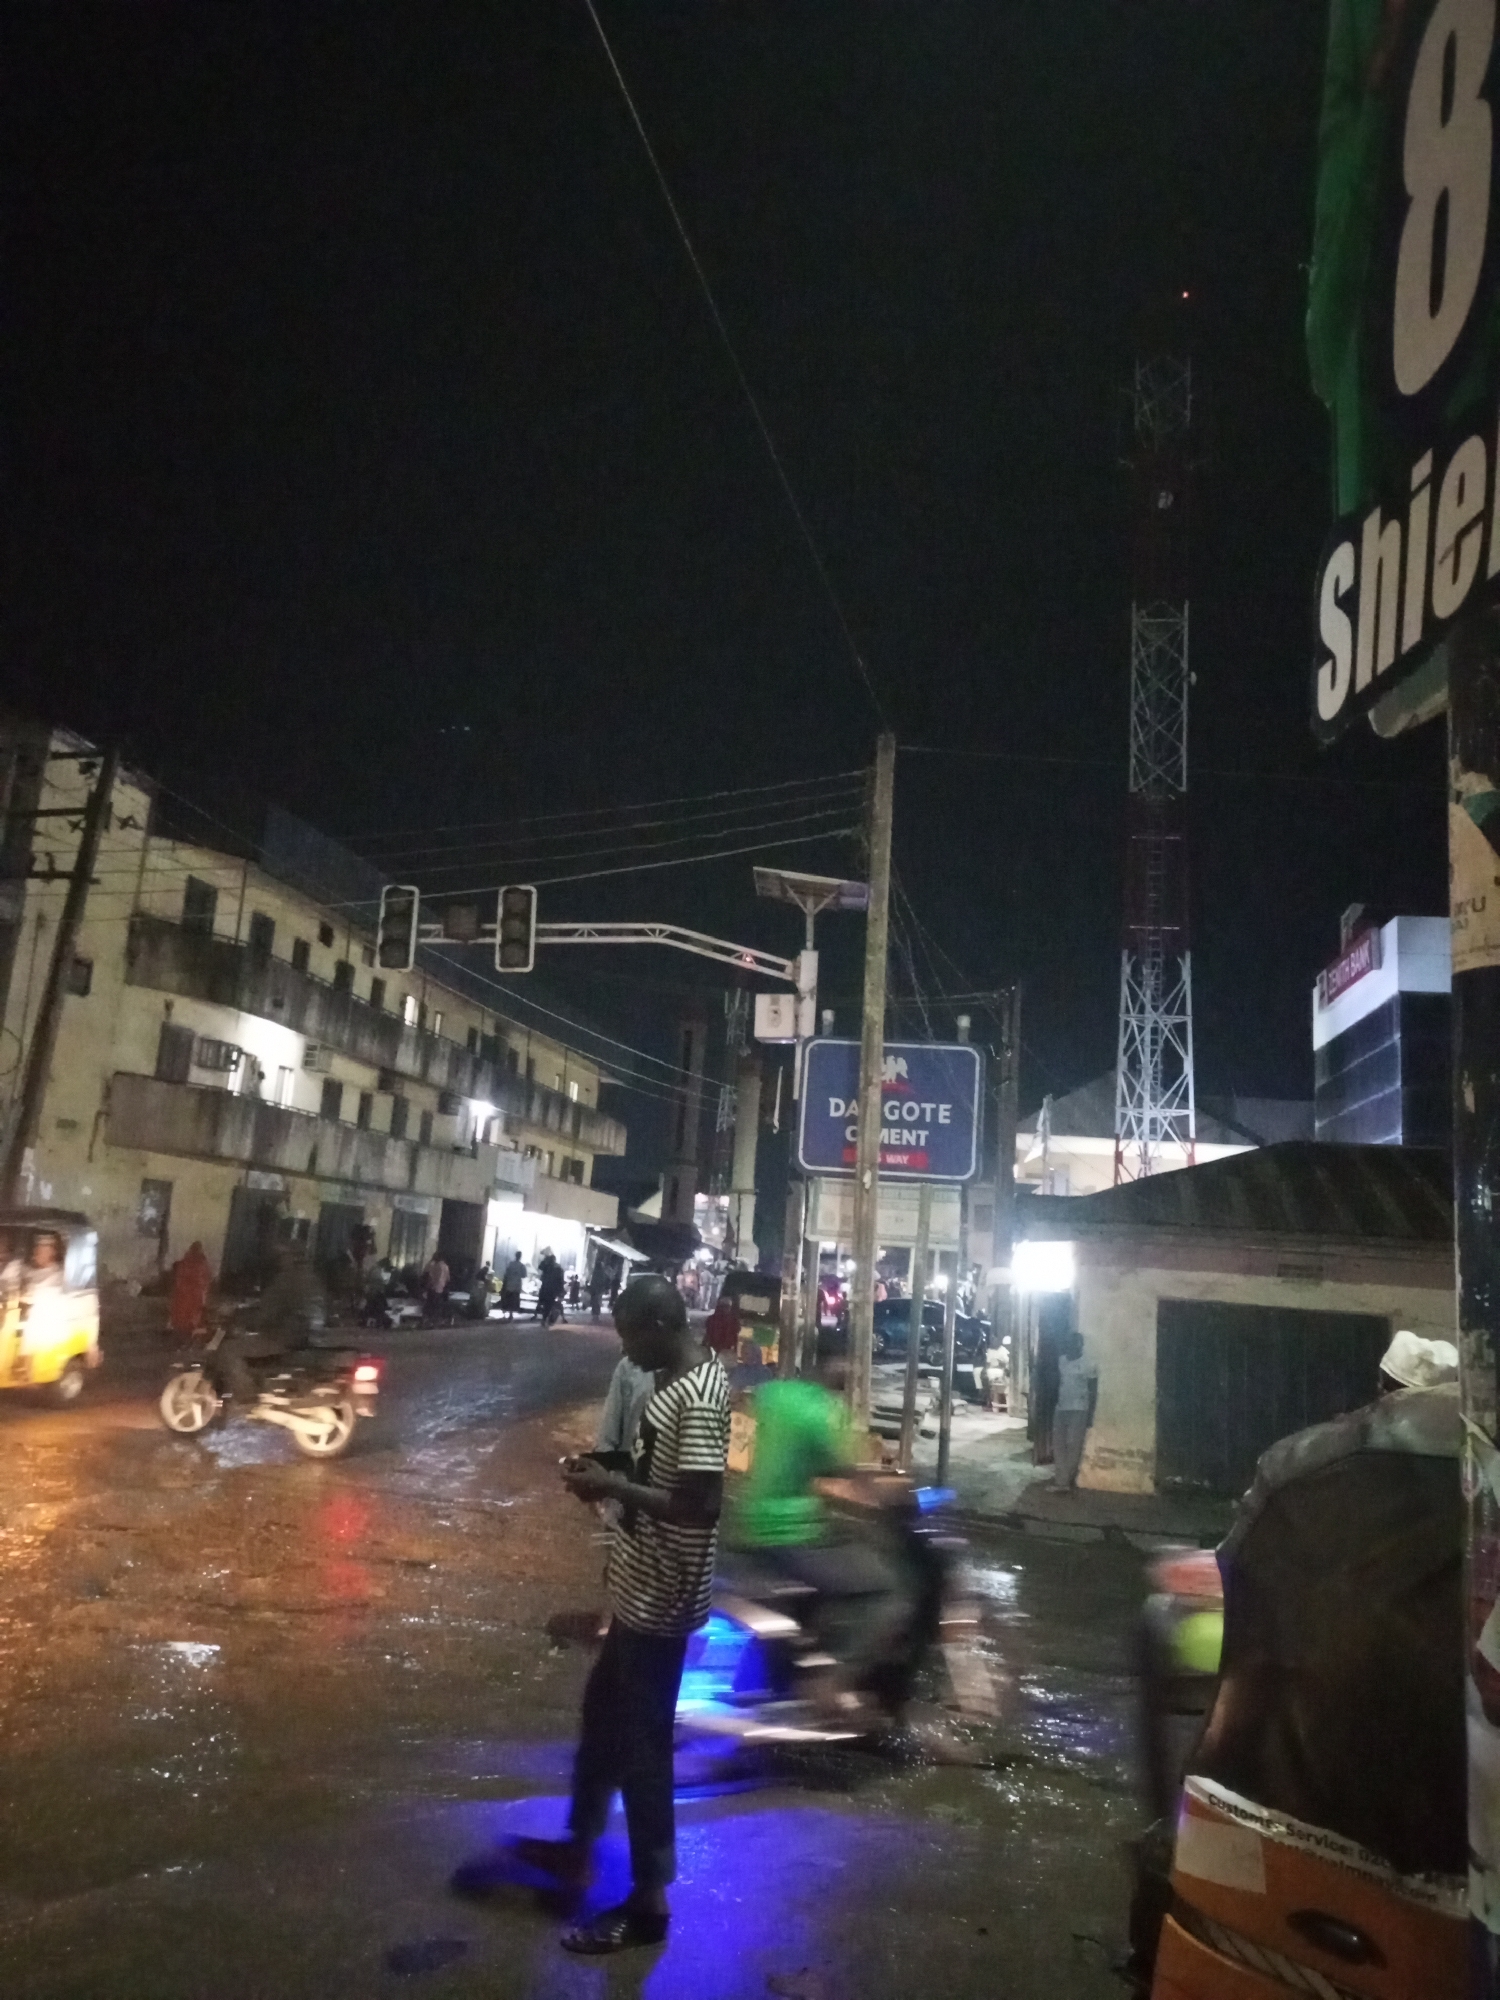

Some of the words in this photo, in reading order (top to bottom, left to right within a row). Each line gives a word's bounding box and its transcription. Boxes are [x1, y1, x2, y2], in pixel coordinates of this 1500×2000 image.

[1350, 939, 1370, 978] BANK
[829, 1097, 952, 1124] DAGOTE
[845, 1125, 929, 1147] CMENT
[886, 1154, 909, 1166] WAY
